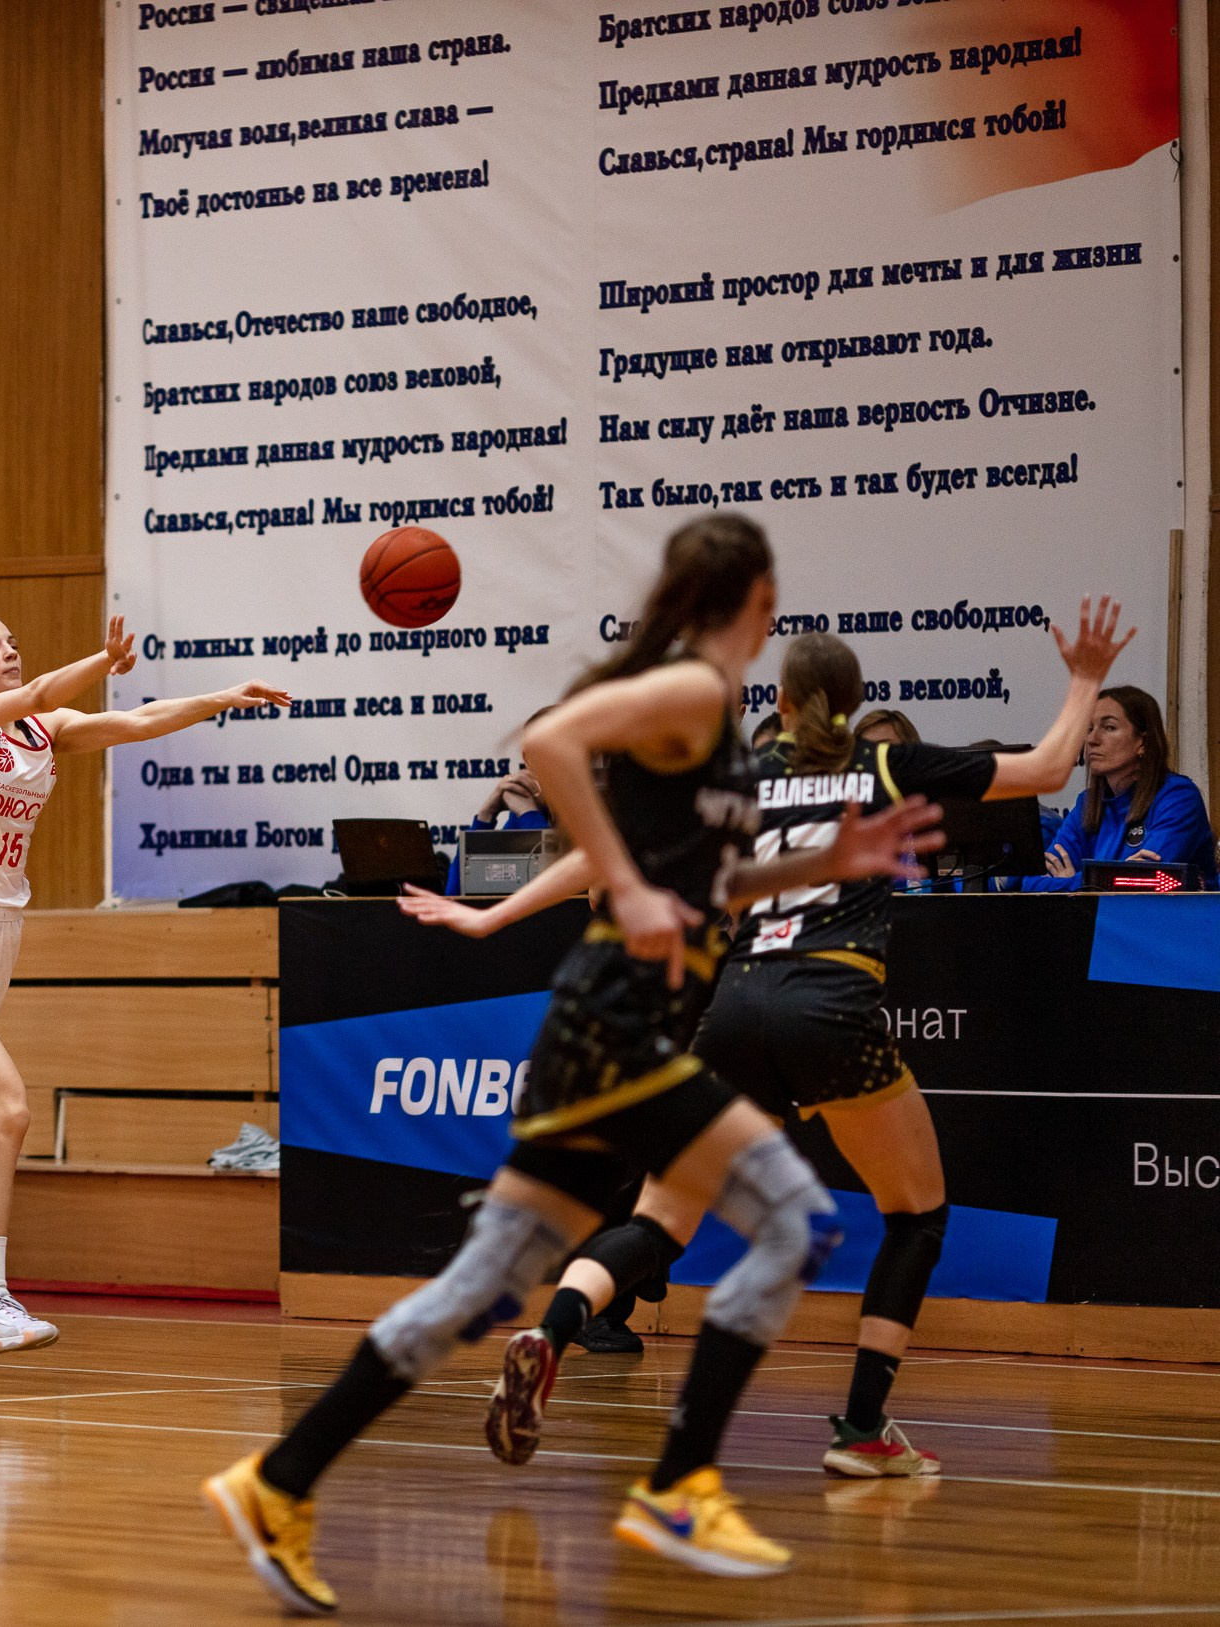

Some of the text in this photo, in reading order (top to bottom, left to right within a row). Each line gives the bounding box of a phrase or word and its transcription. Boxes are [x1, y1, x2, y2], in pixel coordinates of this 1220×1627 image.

[139, 3, 215, 30] Россия
[599, 10, 710, 49] Братских
[719, 0, 819, 33] народов
[138, 66, 215, 93] Россия
[255, 49, 355, 80] любимая
[362, 43, 422, 68] наша
[428, 33, 511, 66] страна.
[599, 27, 1082, 115] Предками данная мудрость народная!
[138, 128, 232, 159] Могучая
[395, 104, 459, 129] слава
[802, 125, 848, 155] Мы
[856, 114, 976, 153] гордимся
[984, 100, 1067, 138] тобой!
[139, 159, 489, 219] Твоё достоянье на все времена!
[599, 242, 1142, 314] Широкий простор для мечты и для жизни
[352, 305, 409, 329] наше
[416, 292, 537, 323] свободное,
[599, 327, 993, 383] Грядущие нам открывают года.
[143, 356, 501, 414] Братских народов союз вековой,
[599, 388, 1096, 444] Нам силу даёт наша верность Отчизне.
[144, 417, 567, 477] Предками данная мудрость народная!
[322, 497, 361, 524] Мы
[369, 497, 475, 527] гордимся
[482, 484, 554, 515] тобой!
[599, 481, 644, 509] Так
[770, 477, 822, 500] есть
[830, 475, 847, 497] и
[854, 472, 899, 495] так
[906, 462, 978, 499] будет
[986, 453, 1078, 489] всегда!
[837, 611, 903, 634] наше
[911, 599, 1051, 633] свободное,
[142, 625, 549, 662] От южных морей до полярного края
[289, 698, 346, 719] наши
[353, 696, 404, 717] леса
[410, 695, 425, 715] и
[432, 693, 493, 714] поля.
[899, 668, 1010, 705] вековой,
[141, 755, 510, 790] Одна ты на свете! Одна ты такая
[757, 772, 875, 810] ЕДЛЕЦКАЯ
[139, 823, 247, 856] Хранимая
[256, 821, 324, 848] Богом
[1134, 1142, 1220, 1189] Выс
